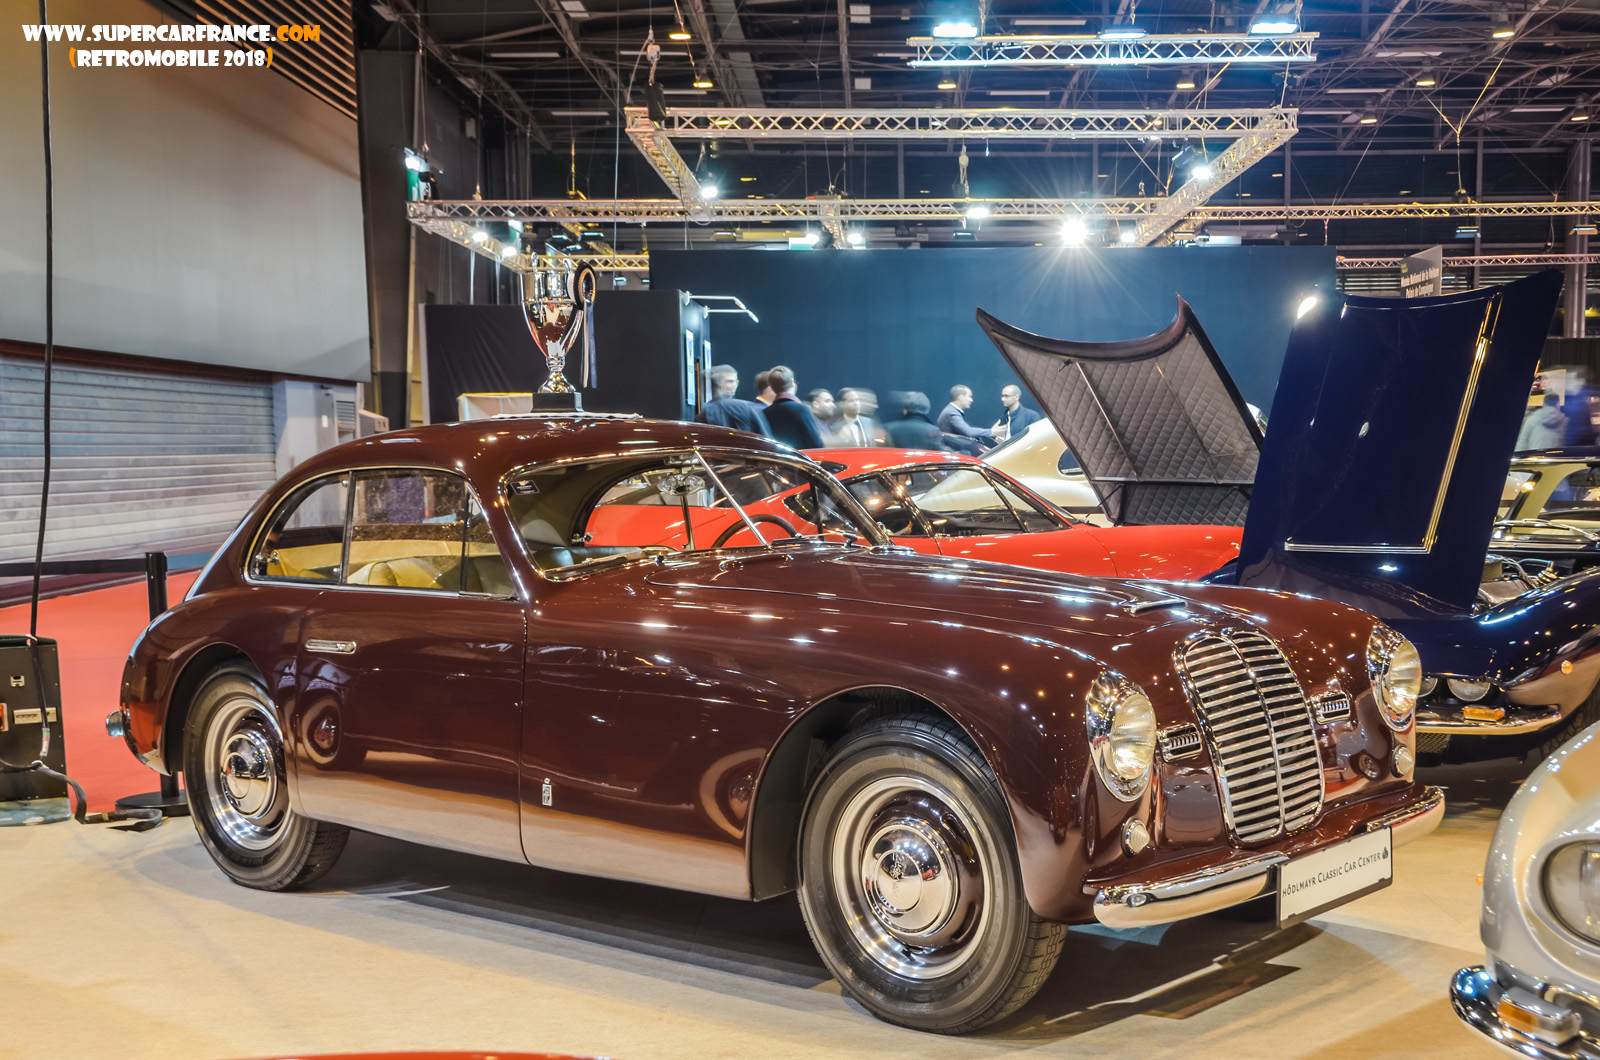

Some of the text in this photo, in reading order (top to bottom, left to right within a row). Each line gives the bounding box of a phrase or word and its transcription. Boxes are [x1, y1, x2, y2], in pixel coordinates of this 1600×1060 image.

[1317, 867, 1343, 883] CLASSIC
[1344, 861, 1357, 873] CAR
[1358, 852, 1381, 868] CENTER
